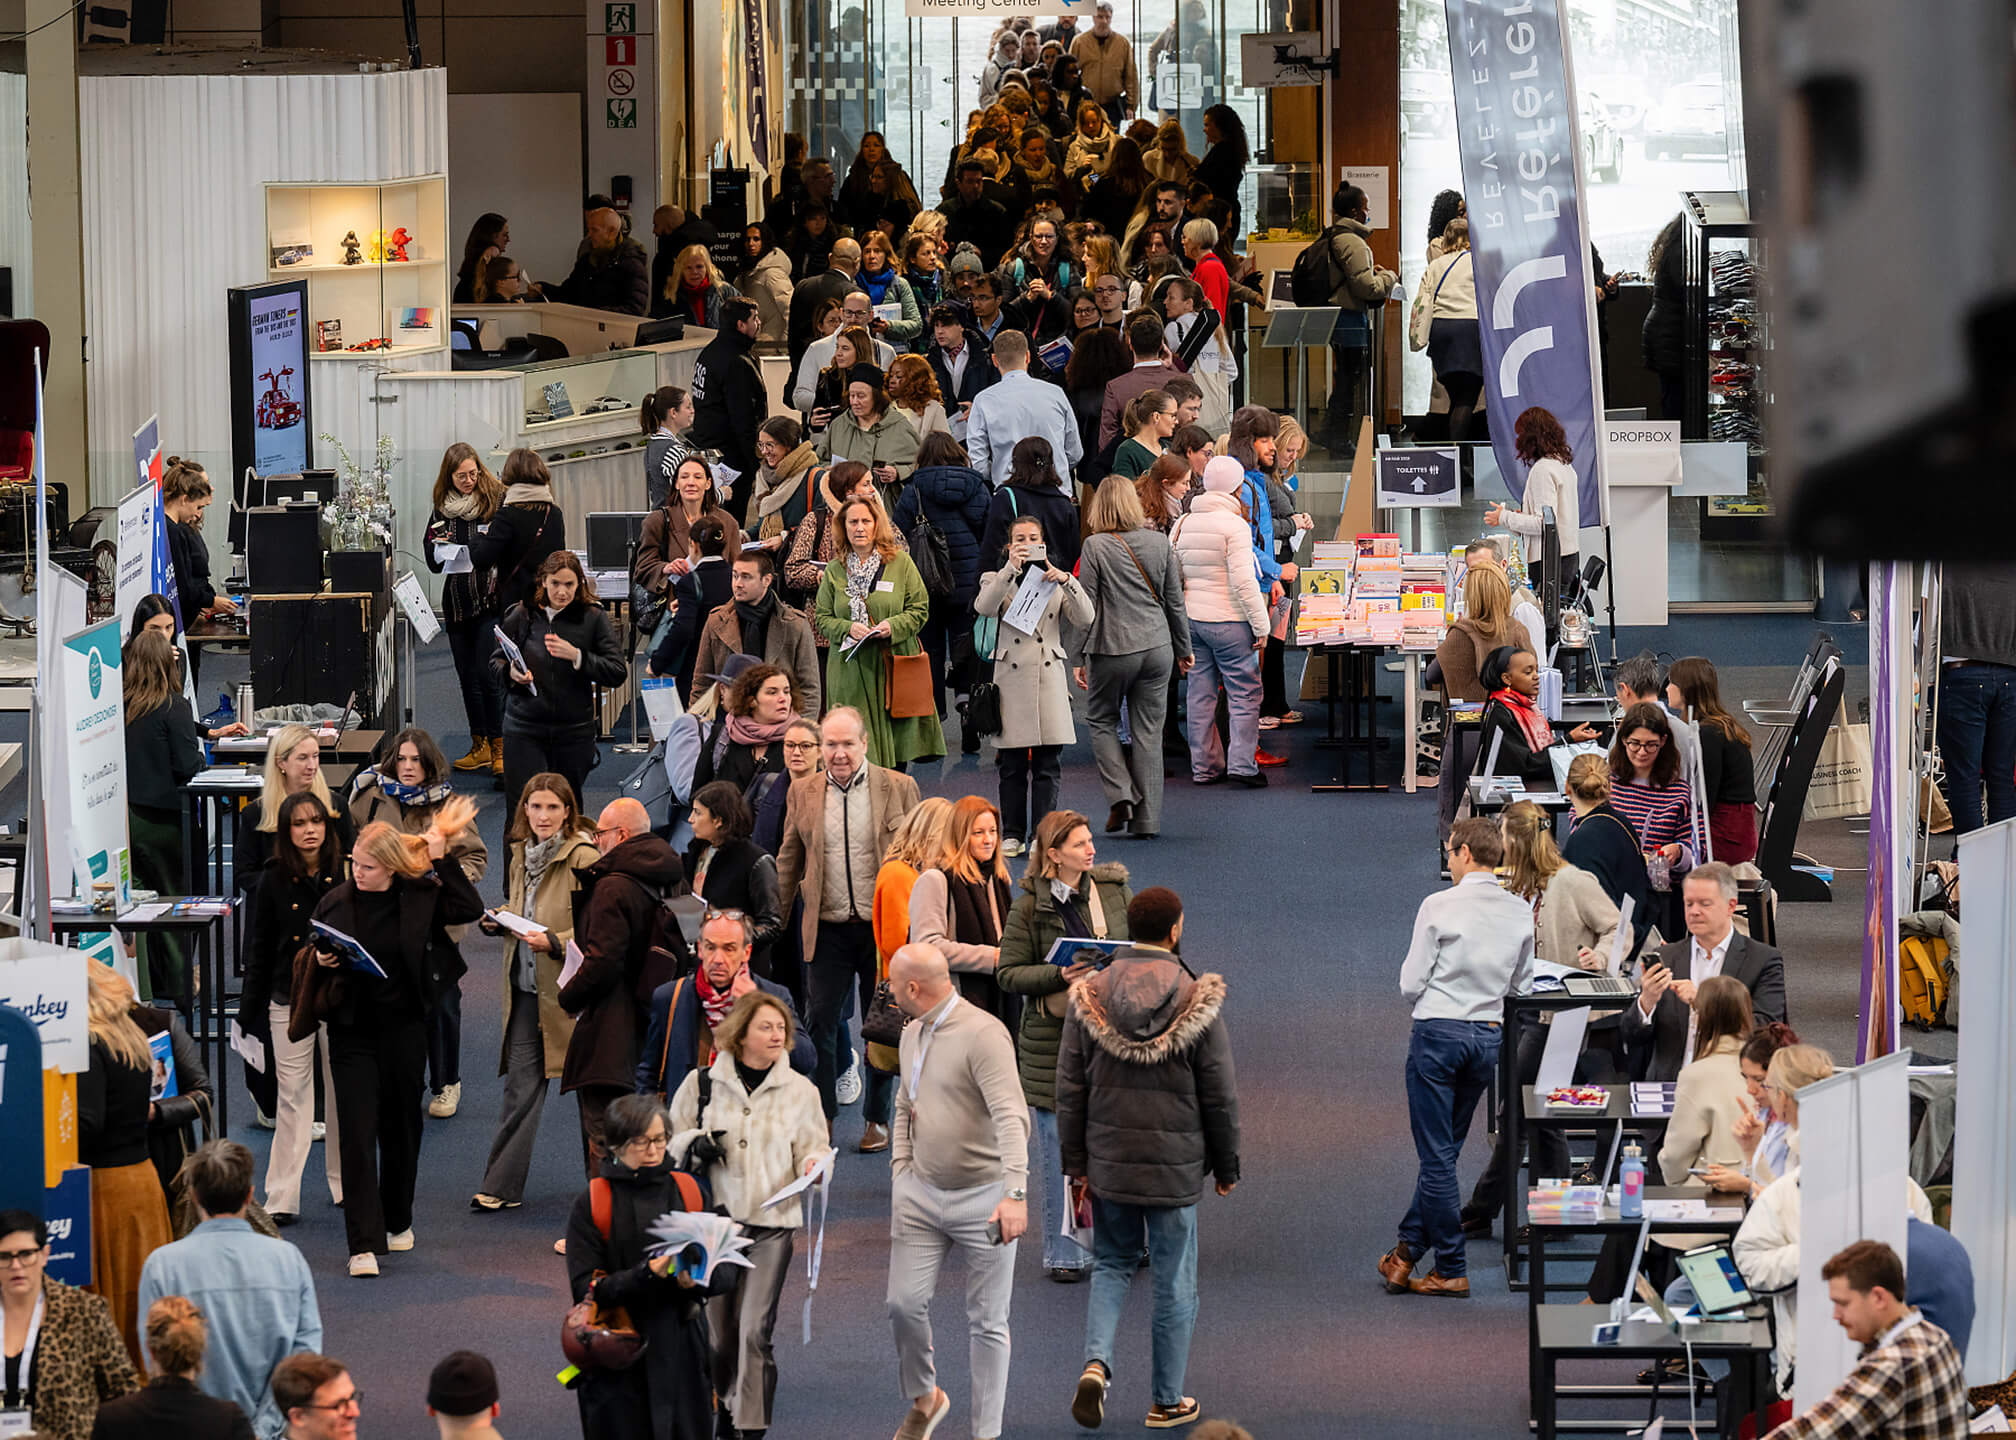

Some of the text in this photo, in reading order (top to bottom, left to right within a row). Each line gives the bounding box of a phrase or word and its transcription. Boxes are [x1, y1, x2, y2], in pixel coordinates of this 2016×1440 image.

[924, 0, 985, 9] Meeting
[608, 120, 635, 128] DEA
[710, 243, 730, 252] our
[1610, 431, 1672, 442] DROPBOX
[1839, 767, 1862, 776] COACH
